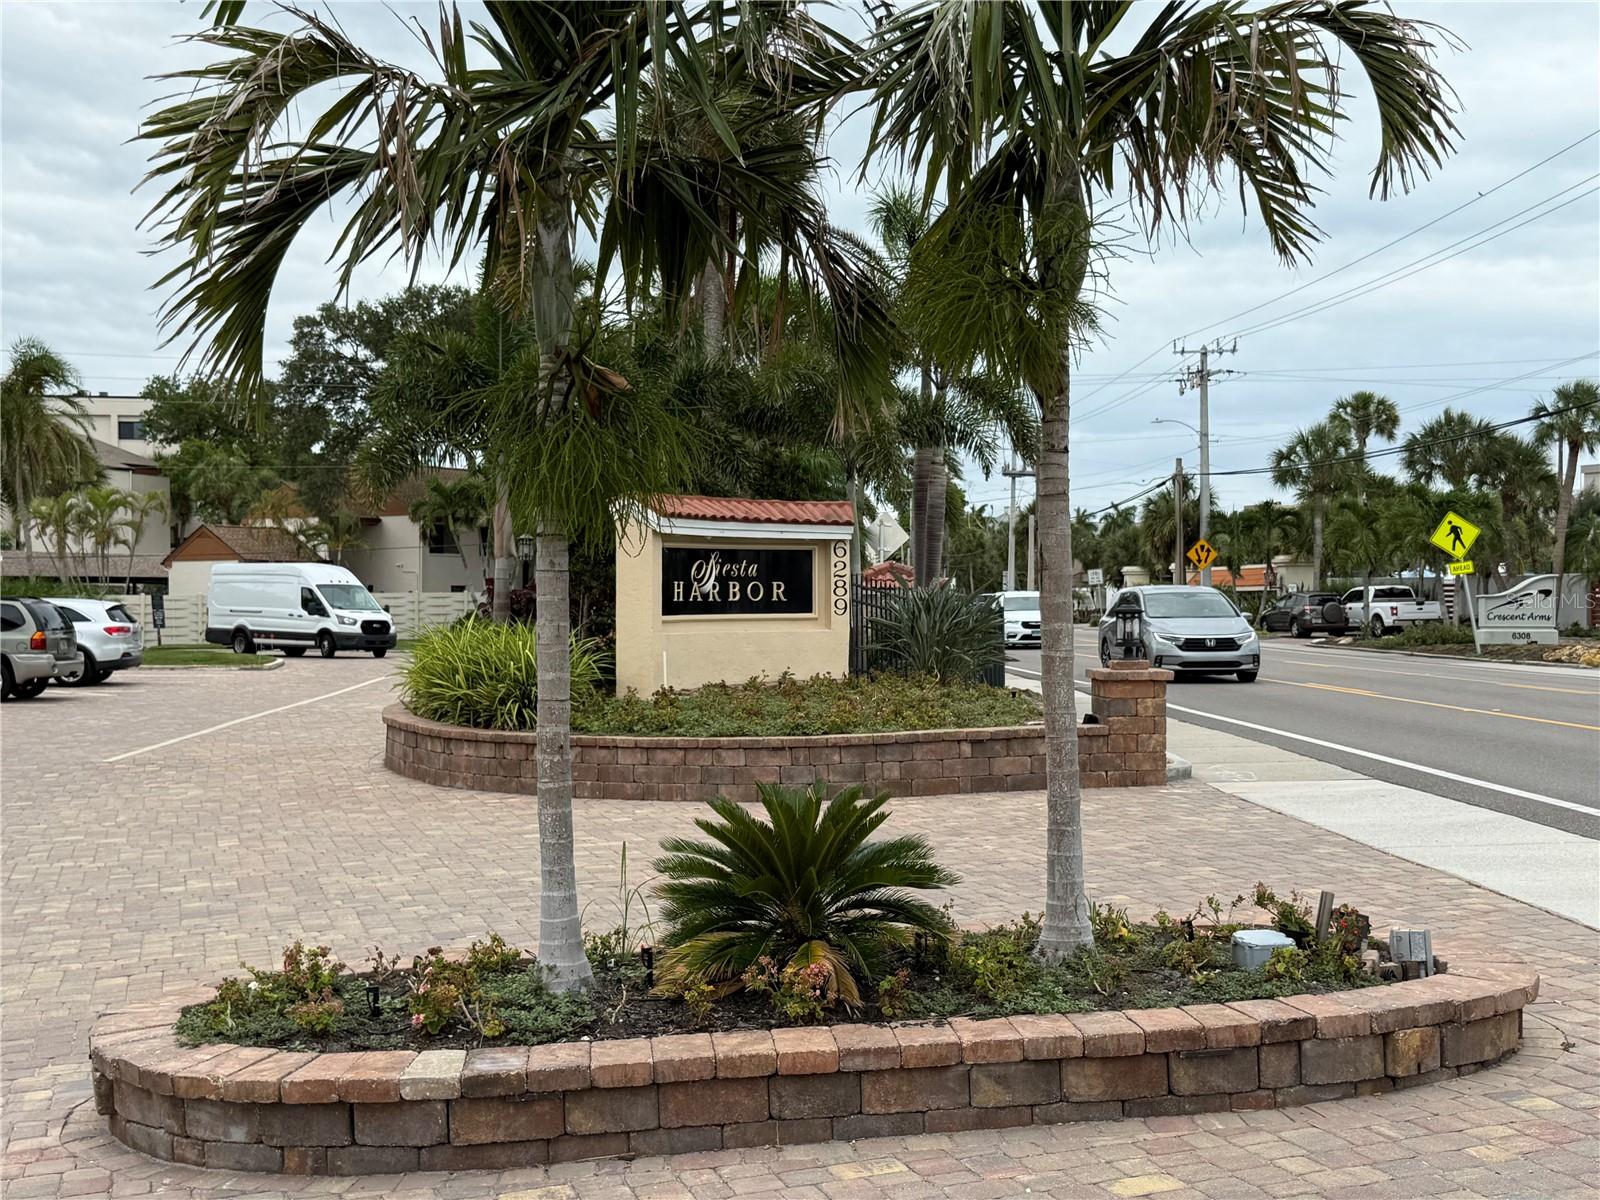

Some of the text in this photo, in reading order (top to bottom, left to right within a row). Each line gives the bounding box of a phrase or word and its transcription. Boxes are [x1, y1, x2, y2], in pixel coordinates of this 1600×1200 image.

[691, 551, 758, 586] Siesta
[1452, 563, 1471, 573] AHEAD
[833, 539, 848, 616] 6289
[673, 581, 787, 602] HARBOR
[1487, 611, 1552, 622] Crescent Arms
[1512, 632, 1531, 640] 6308
